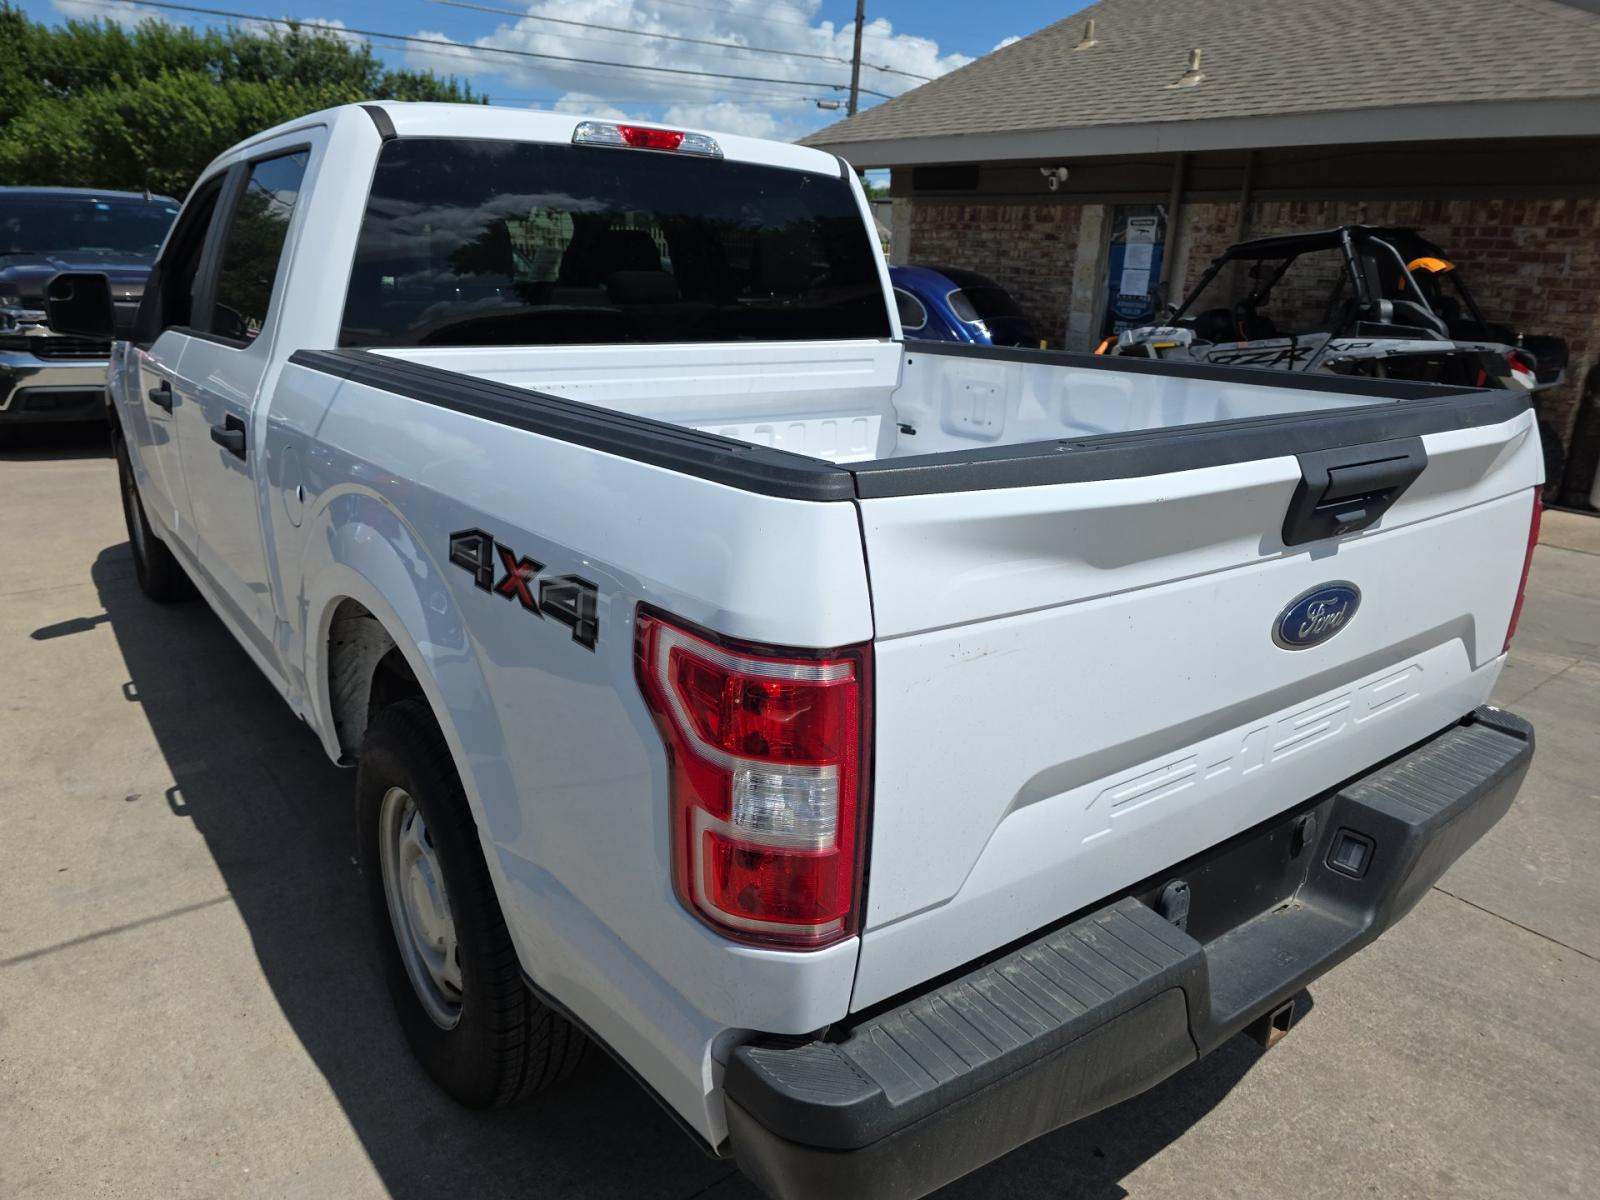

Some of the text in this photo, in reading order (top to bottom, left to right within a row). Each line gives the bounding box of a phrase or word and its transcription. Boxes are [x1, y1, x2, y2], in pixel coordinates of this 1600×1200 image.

[1328, 343, 1374, 352] XP
[1298, 596, 1348, 639] Ford
[1081, 662, 1425, 845] F-150
